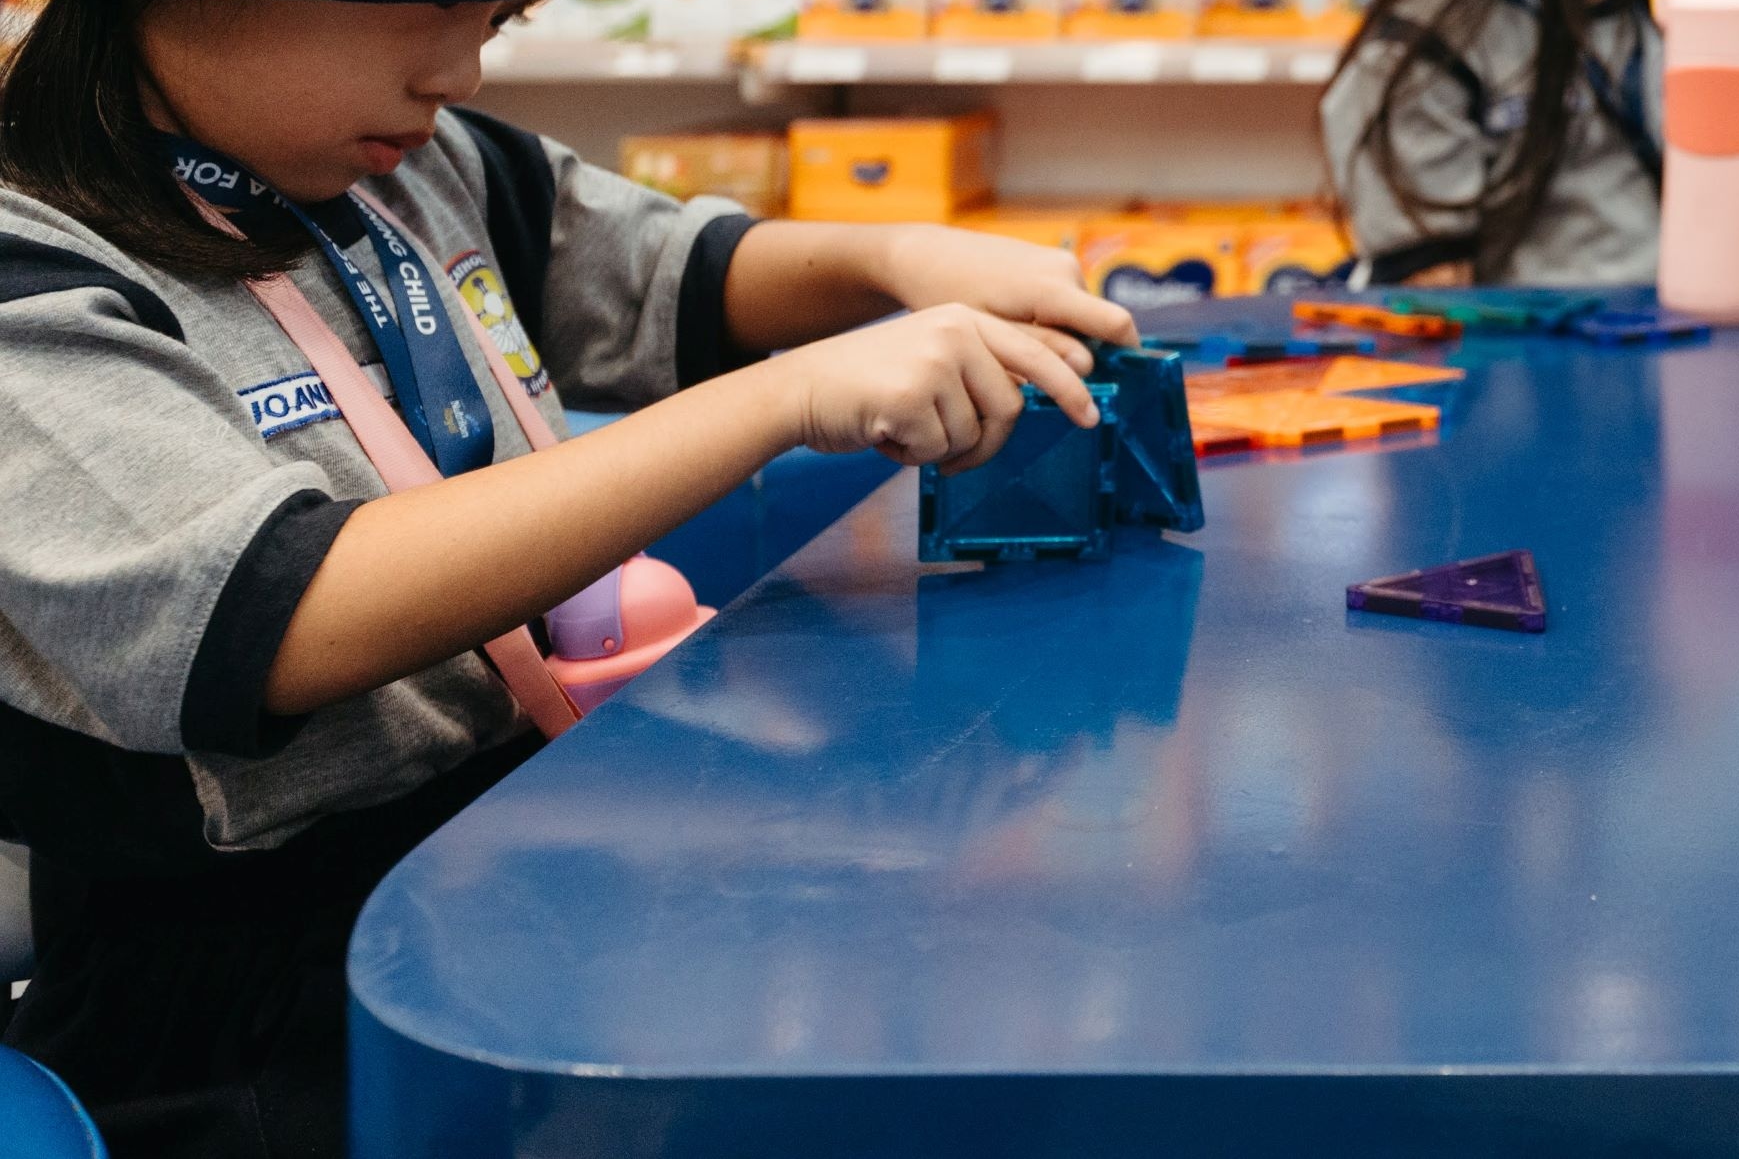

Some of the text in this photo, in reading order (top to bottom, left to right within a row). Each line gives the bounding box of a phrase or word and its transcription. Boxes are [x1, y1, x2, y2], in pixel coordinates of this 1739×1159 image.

[174, 156, 240, 189] FOR
[356, 280, 389, 329] THE
[400, 262, 438, 335] CHILD
